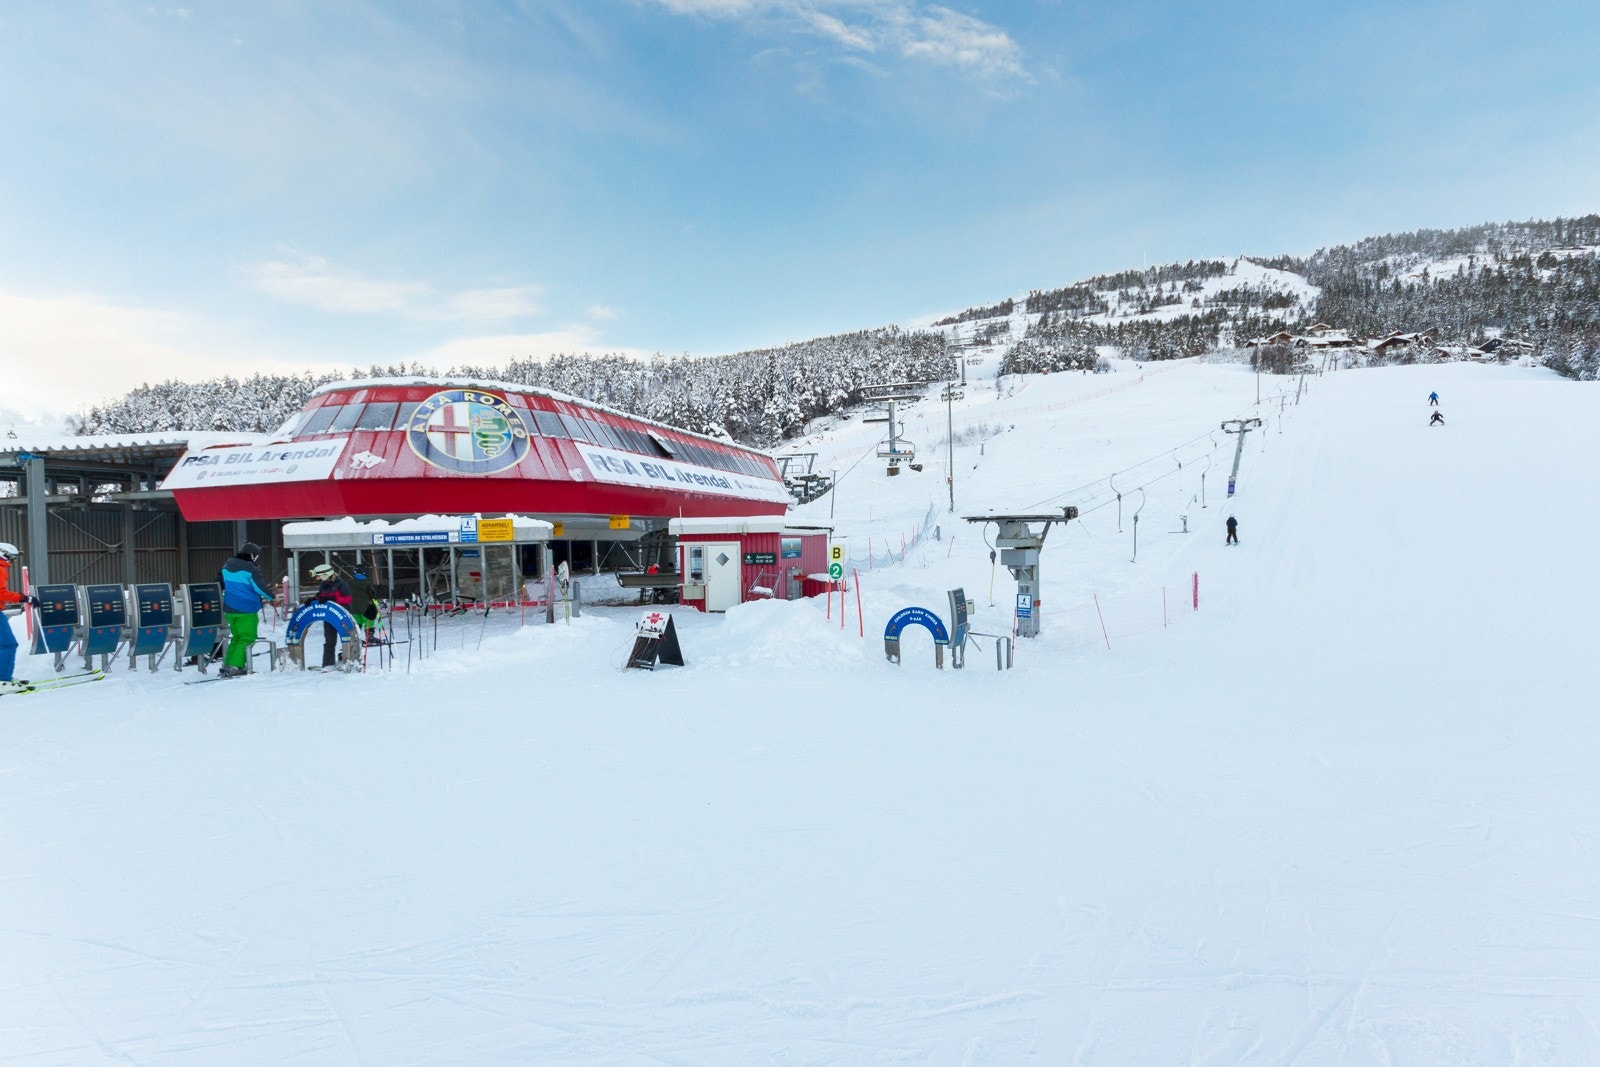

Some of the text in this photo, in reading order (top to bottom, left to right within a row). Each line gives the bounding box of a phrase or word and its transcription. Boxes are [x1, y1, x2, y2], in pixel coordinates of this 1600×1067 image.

[411, 392, 526, 439] ALFA ROMEO
[182, 446, 338, 468] RSA BIL Arendal
[586, 452, 733, 490] RSA BIL Arendal
[832, 547, 841, 559] B
[832, 566, 840, 578] 2
[296, 606, 314, 622] CHILDREN
[328, 606, 344, 620] KINDER
[894, 610, 910, 622] CHILDREN
[925, 613, 938, 625] KINDER
